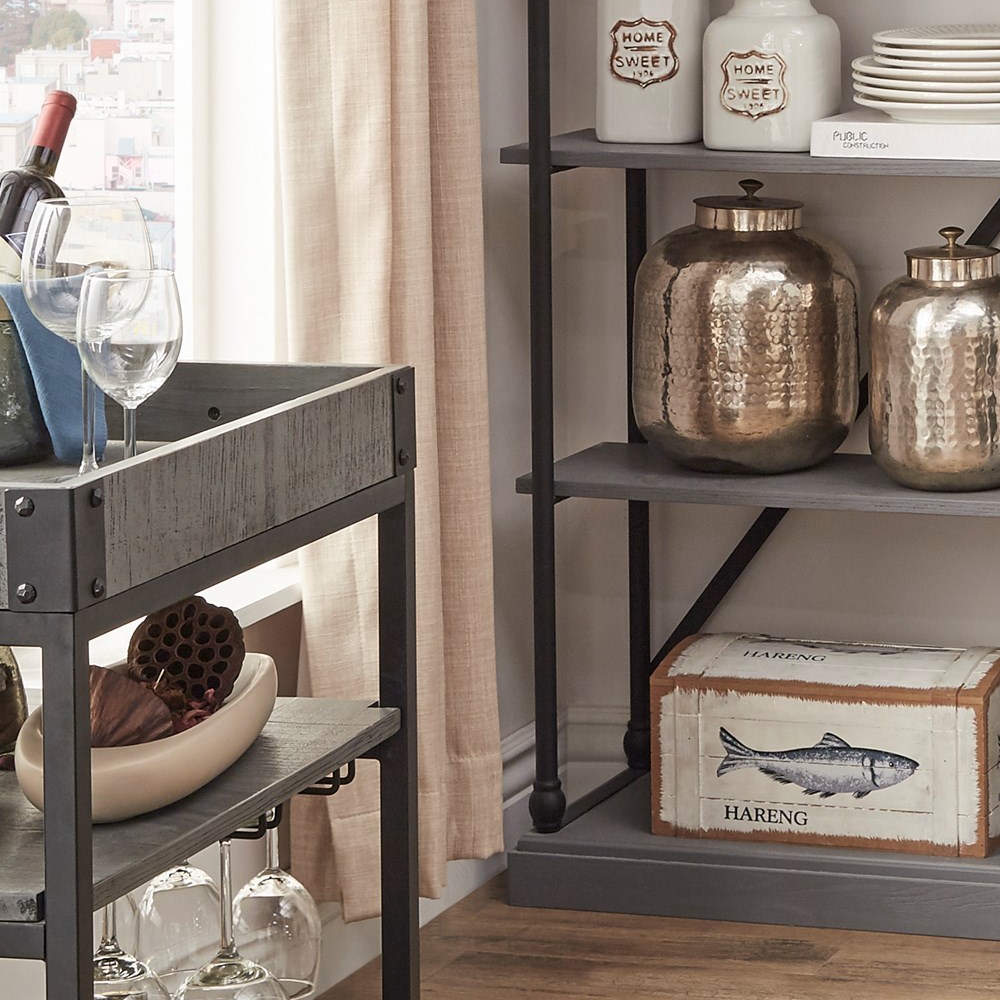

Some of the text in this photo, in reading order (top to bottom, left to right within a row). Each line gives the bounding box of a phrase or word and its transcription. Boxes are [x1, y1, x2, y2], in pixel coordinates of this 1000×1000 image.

[622, 32, 663, 43] HOME
[616, 56, 670, 68] SWEET
[734, 64, 774, 75] HOME
[727, 88, 779, 101] SWEET
[833, 131, 868, 141] PUBLIC
[743, 649, 827, 662] HARENG
[724, 804, 809, 827] HARENG
